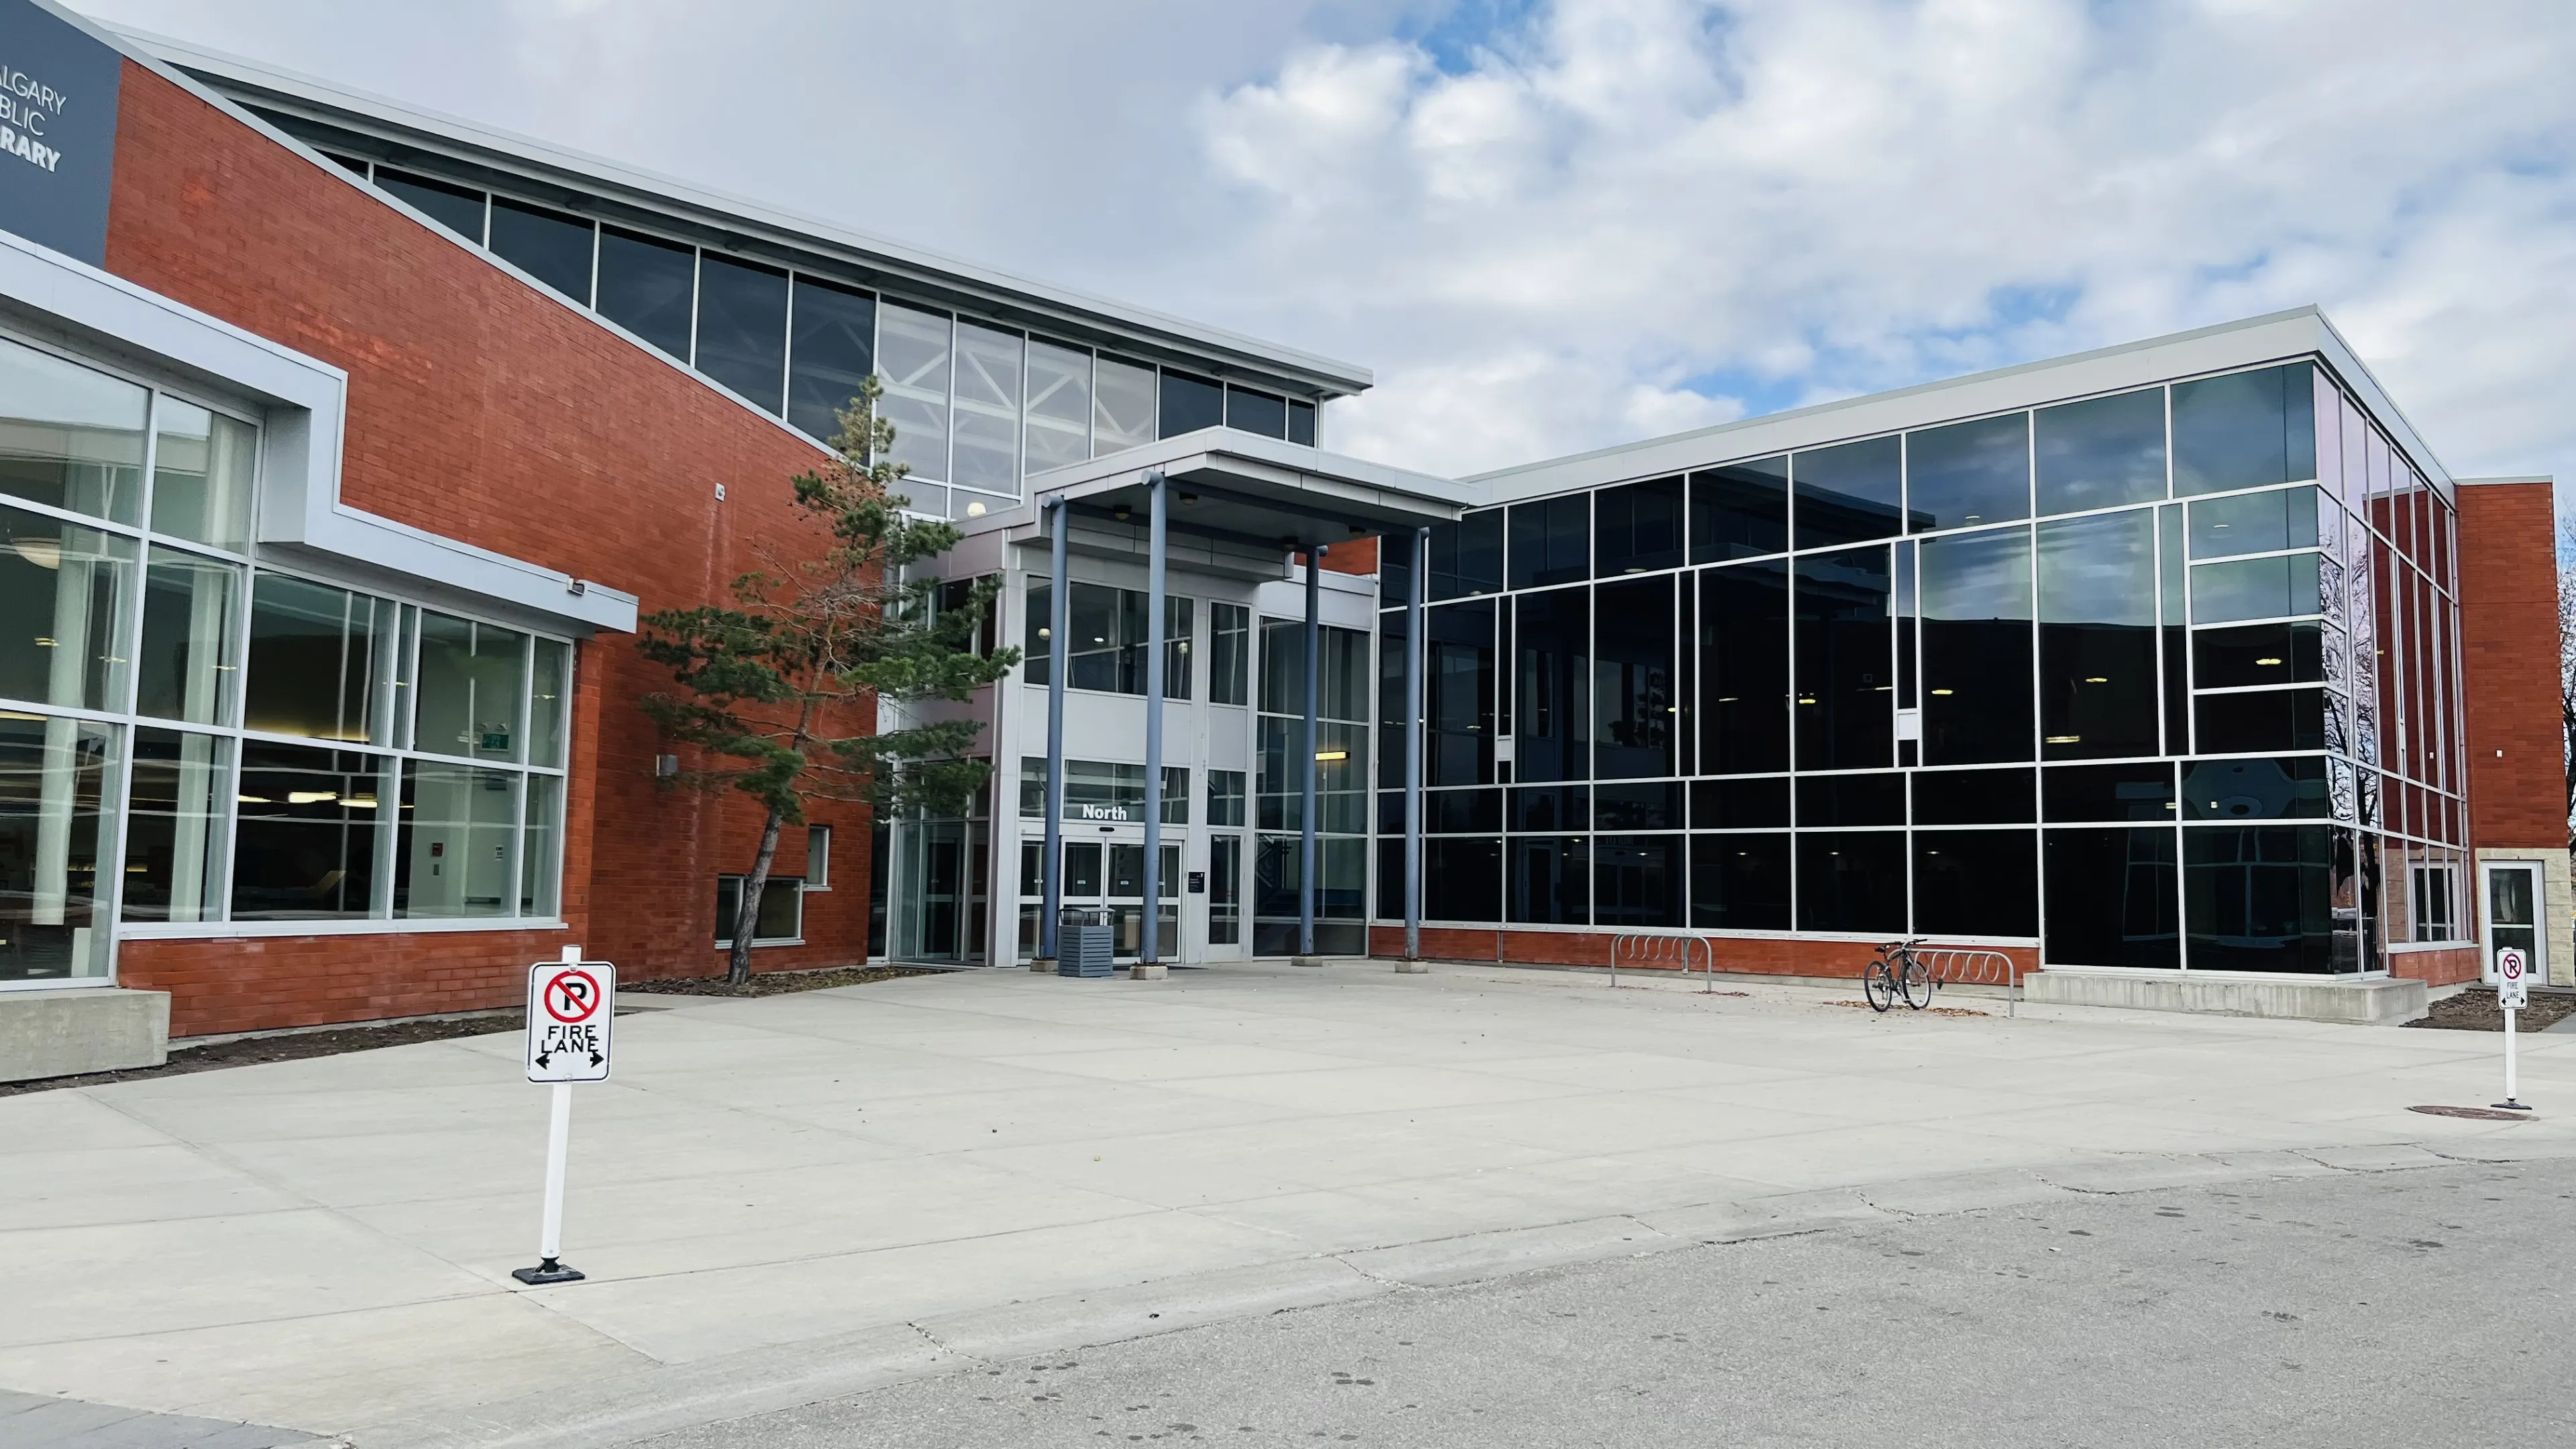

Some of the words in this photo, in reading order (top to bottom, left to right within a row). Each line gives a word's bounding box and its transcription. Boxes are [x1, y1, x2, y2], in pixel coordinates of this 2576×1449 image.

[0, 66, 66, 115] LGARY
[1083, 804, 1127, 820] North
[2507, 981, 2518, 989] FIRE
[2506, 991, 2519, 999] LANE
[547, 1025, 596, 1040] FIRE
[541, 1038, 599, 1054] LANE
